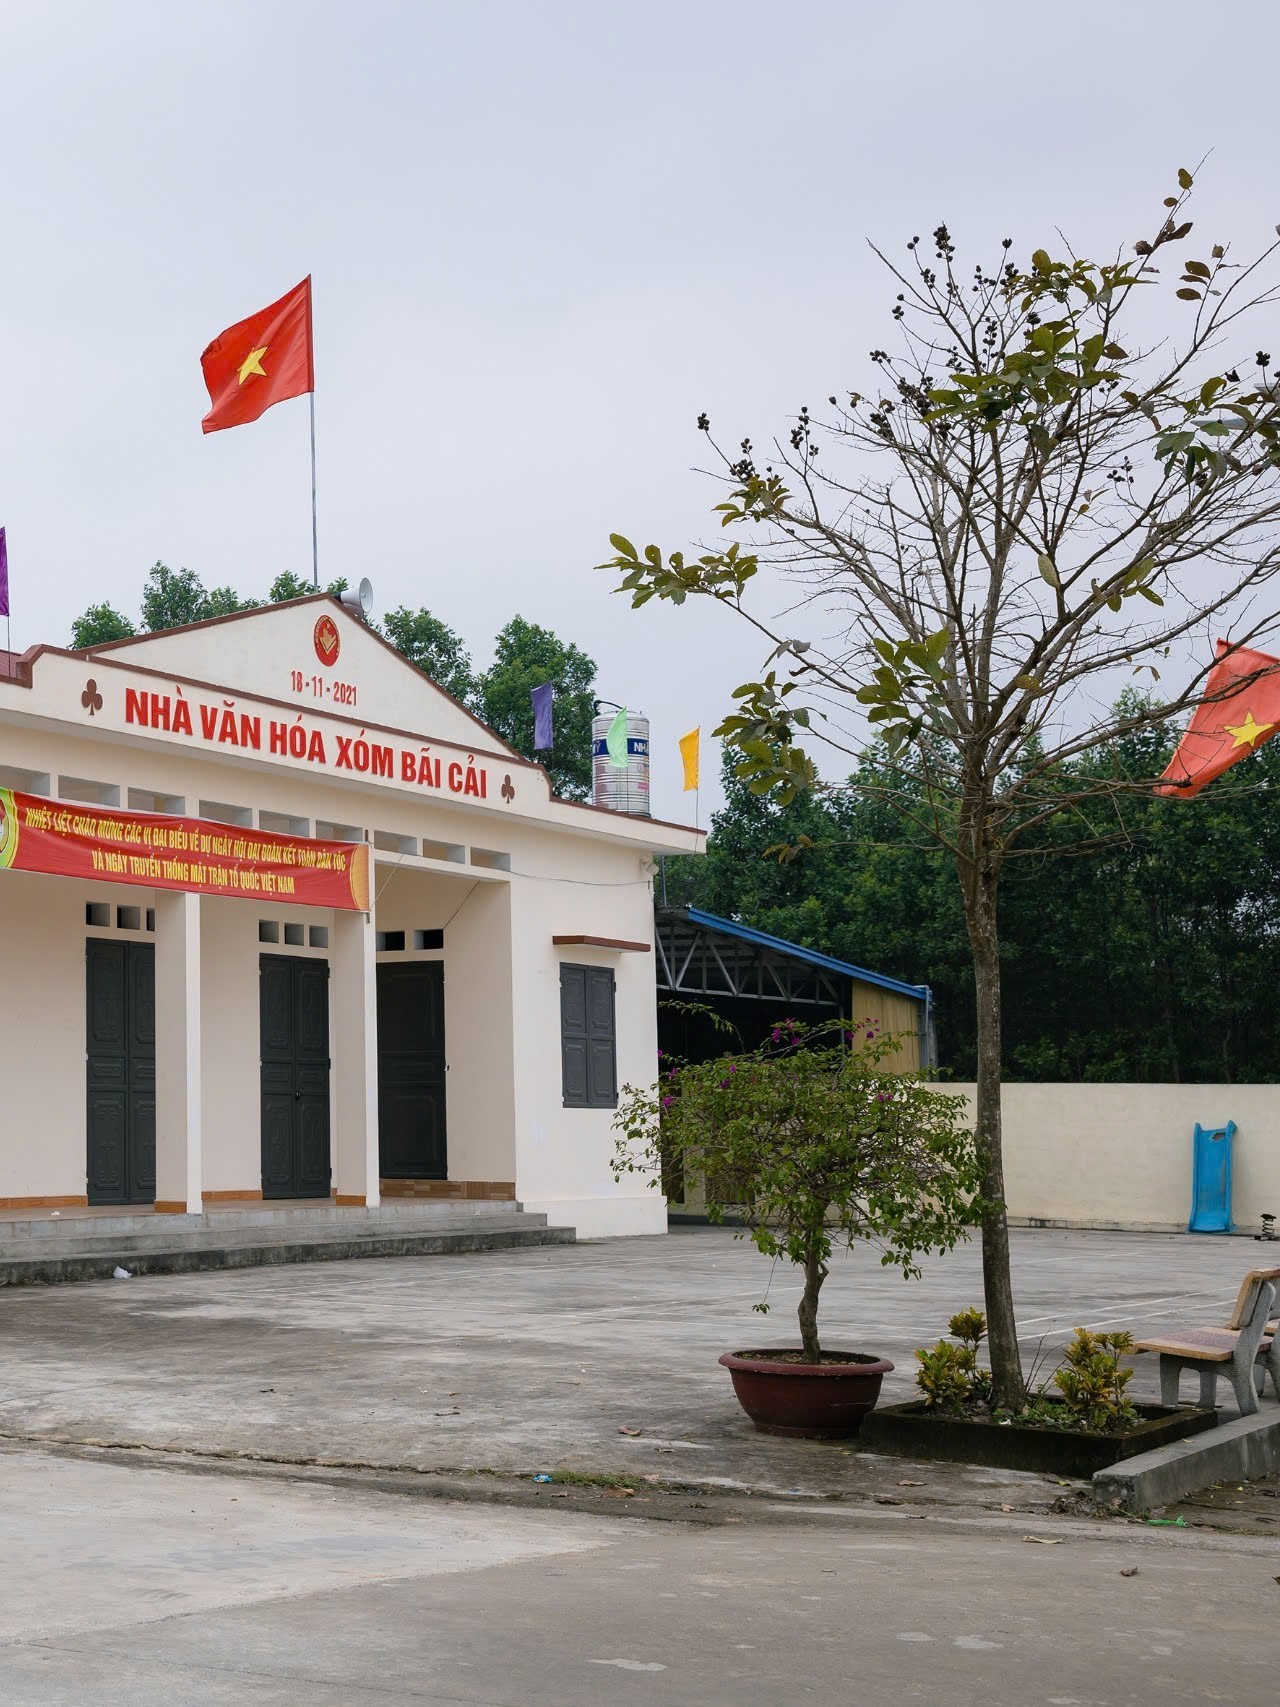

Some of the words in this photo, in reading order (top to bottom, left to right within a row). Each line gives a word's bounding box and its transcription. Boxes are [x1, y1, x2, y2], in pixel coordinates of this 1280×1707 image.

[125, 685, 193, 736] NHÀ
[200, 700, 261, 750] VĂN
[269, 713, 326, 764] HÓA
[335, 729, 394, 779] XÓM
[401, 747, 441, 788] BÃI
[448, 754, 487, 799] CẢI
[25, 806, 51, 833] NHIỆT
[54, 810, 71, 837] LIỆT
[125, 821, 142, 844] CÁC
[143, 826, 151, 849] VỊ
[153, 828, 167, 851] ĐẠI
[169, 824, 188, 851] BIỂU
[201, 835, 211, 857] DỰ
[212, 834, 233, 857] NGÀY
[234, 837, 246, 862] HỘI
[247, 842, 261, 864] ĐẠI
[105, 851, 128, 872] NGÀY
[163, 855, 189, 882] THỐNG
[190, 861, 207, 887] MẶT
[208, 864, 228, 889] TRẬN
[229, 863, 238, 888] TỔ
[239, 866, 259, 891] QUỐC
[261, 871, 276, 895] VIỆT
[278, 876, 295, 894] NAM
